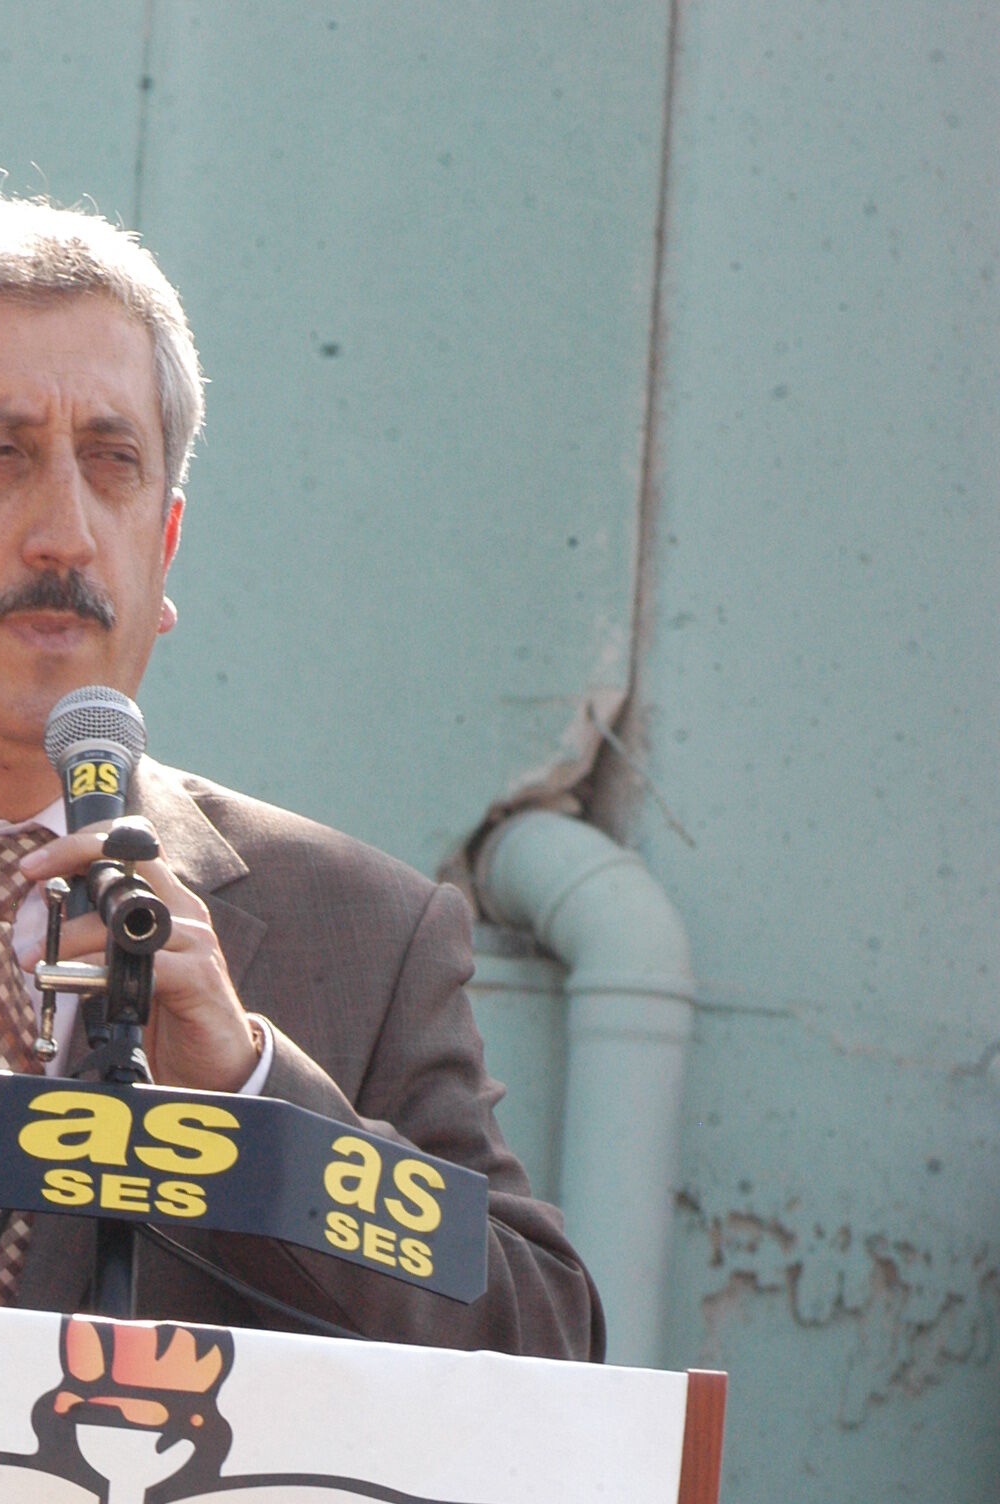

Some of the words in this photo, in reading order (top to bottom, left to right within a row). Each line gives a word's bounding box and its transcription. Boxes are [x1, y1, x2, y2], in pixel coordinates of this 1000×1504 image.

[71, 762, 119, 796] as
[18, 1091, 240, 1175] as
[41, 1169, 208, 1217] SES
[324, 1136, 446, 1233] as
[325, 1210, 434, 1278] SES
